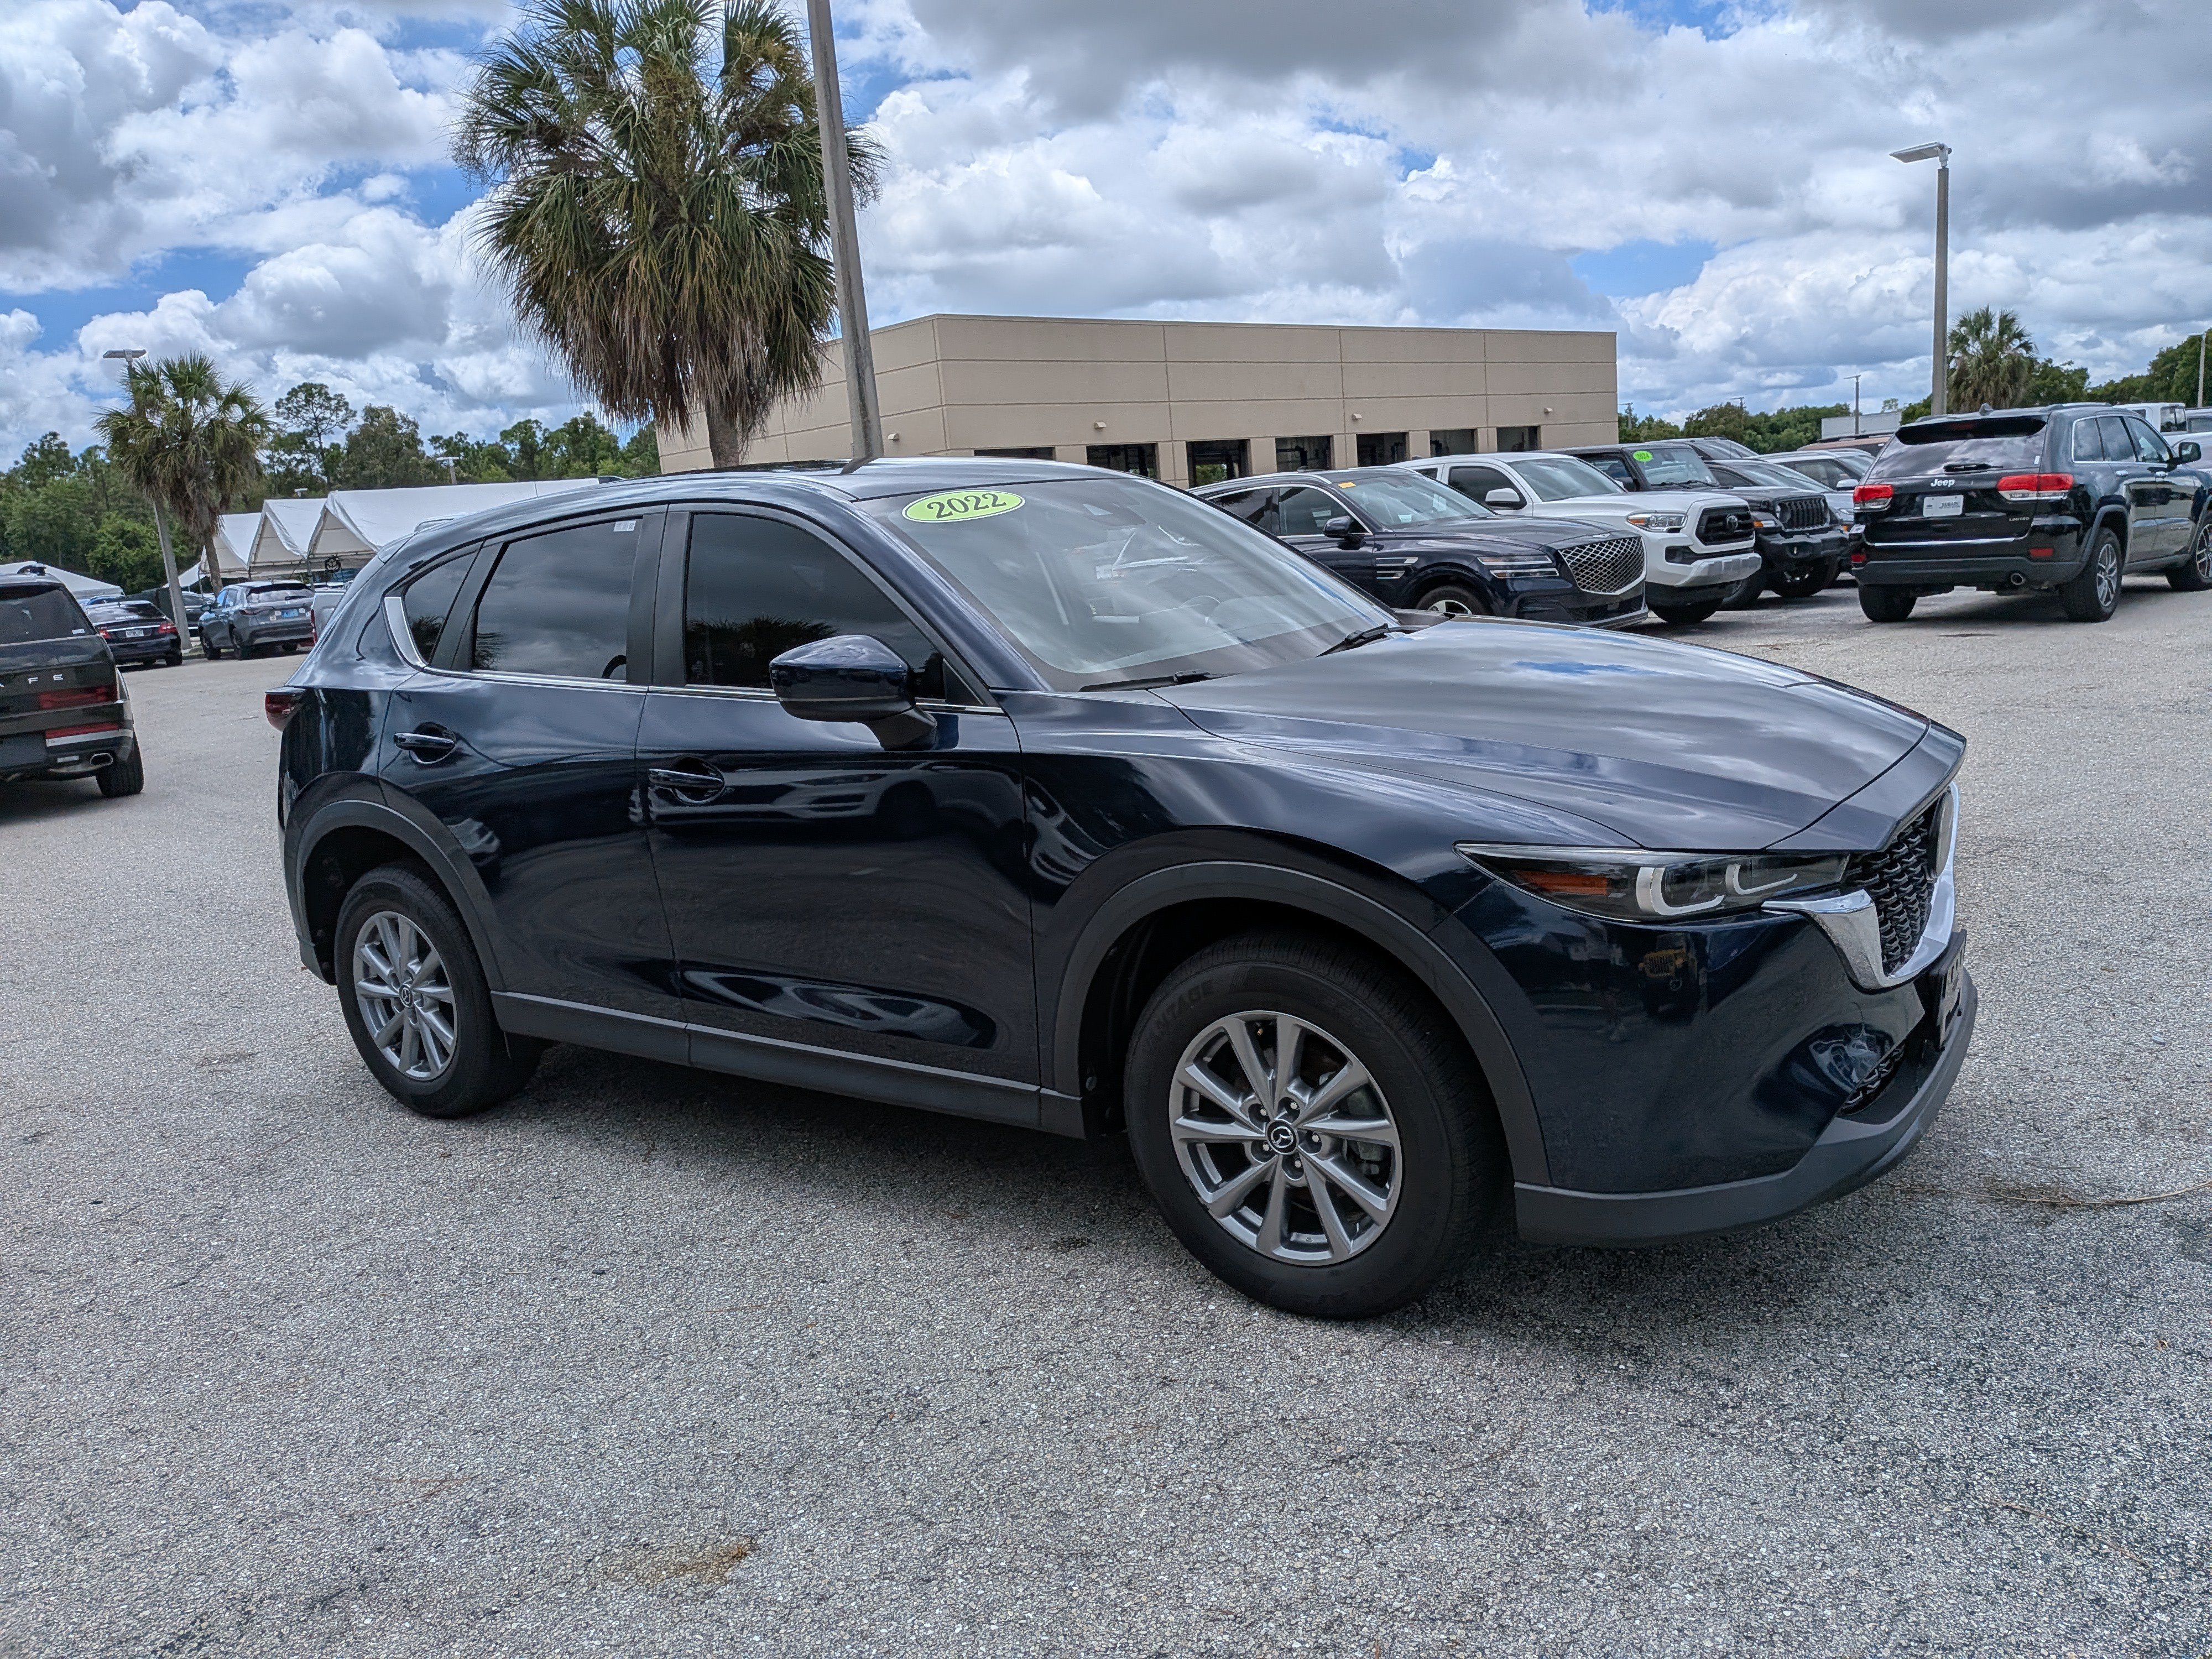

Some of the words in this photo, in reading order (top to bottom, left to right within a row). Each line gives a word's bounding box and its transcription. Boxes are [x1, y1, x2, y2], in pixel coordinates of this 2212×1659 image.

[1931, 478, 1955, 487] Jeep
[927, 493, 1007, 519] 2022
[1142, 978, 1215, 1056] VANTAGE
